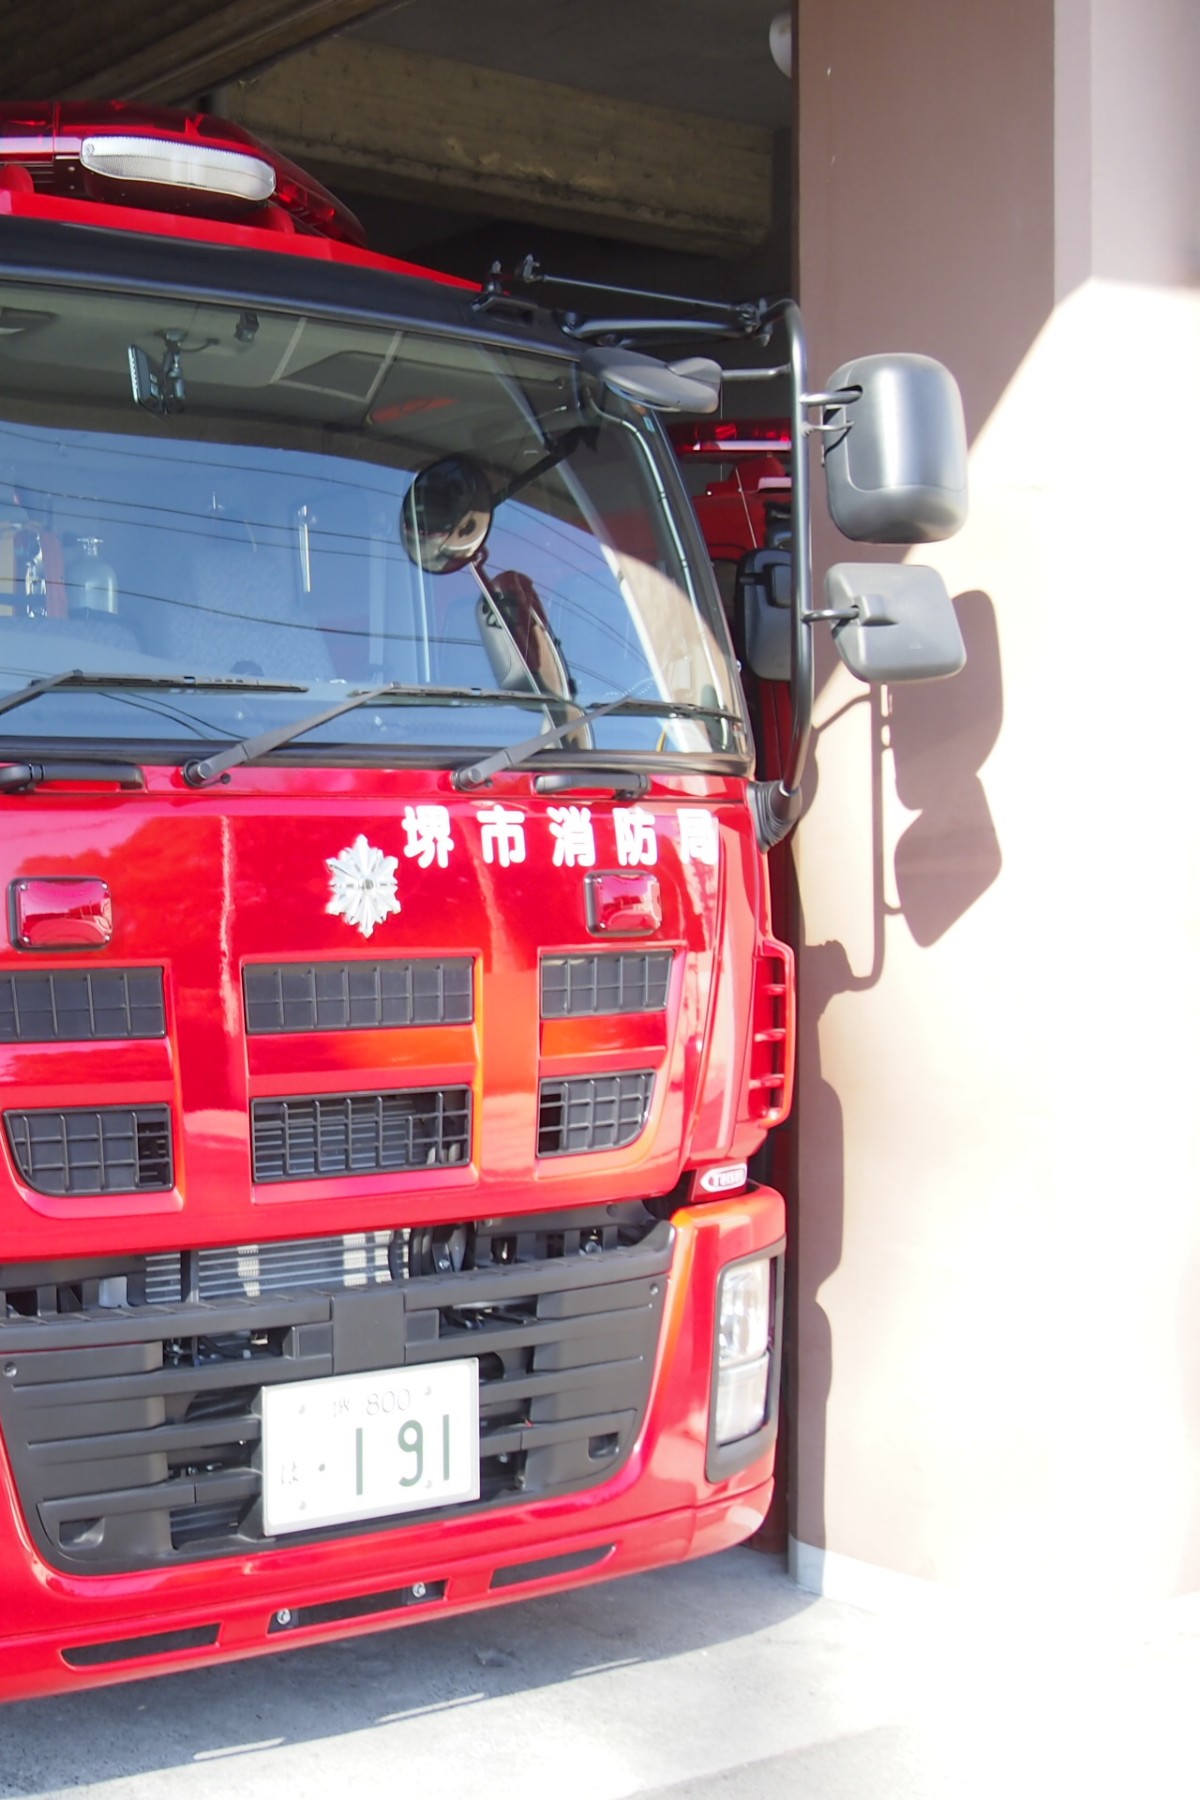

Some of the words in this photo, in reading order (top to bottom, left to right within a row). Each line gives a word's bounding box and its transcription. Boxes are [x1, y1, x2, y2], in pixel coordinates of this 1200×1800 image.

[402, 805, 719, 868] 堺市消防局
[366, 1389, 411, 1415] 800
